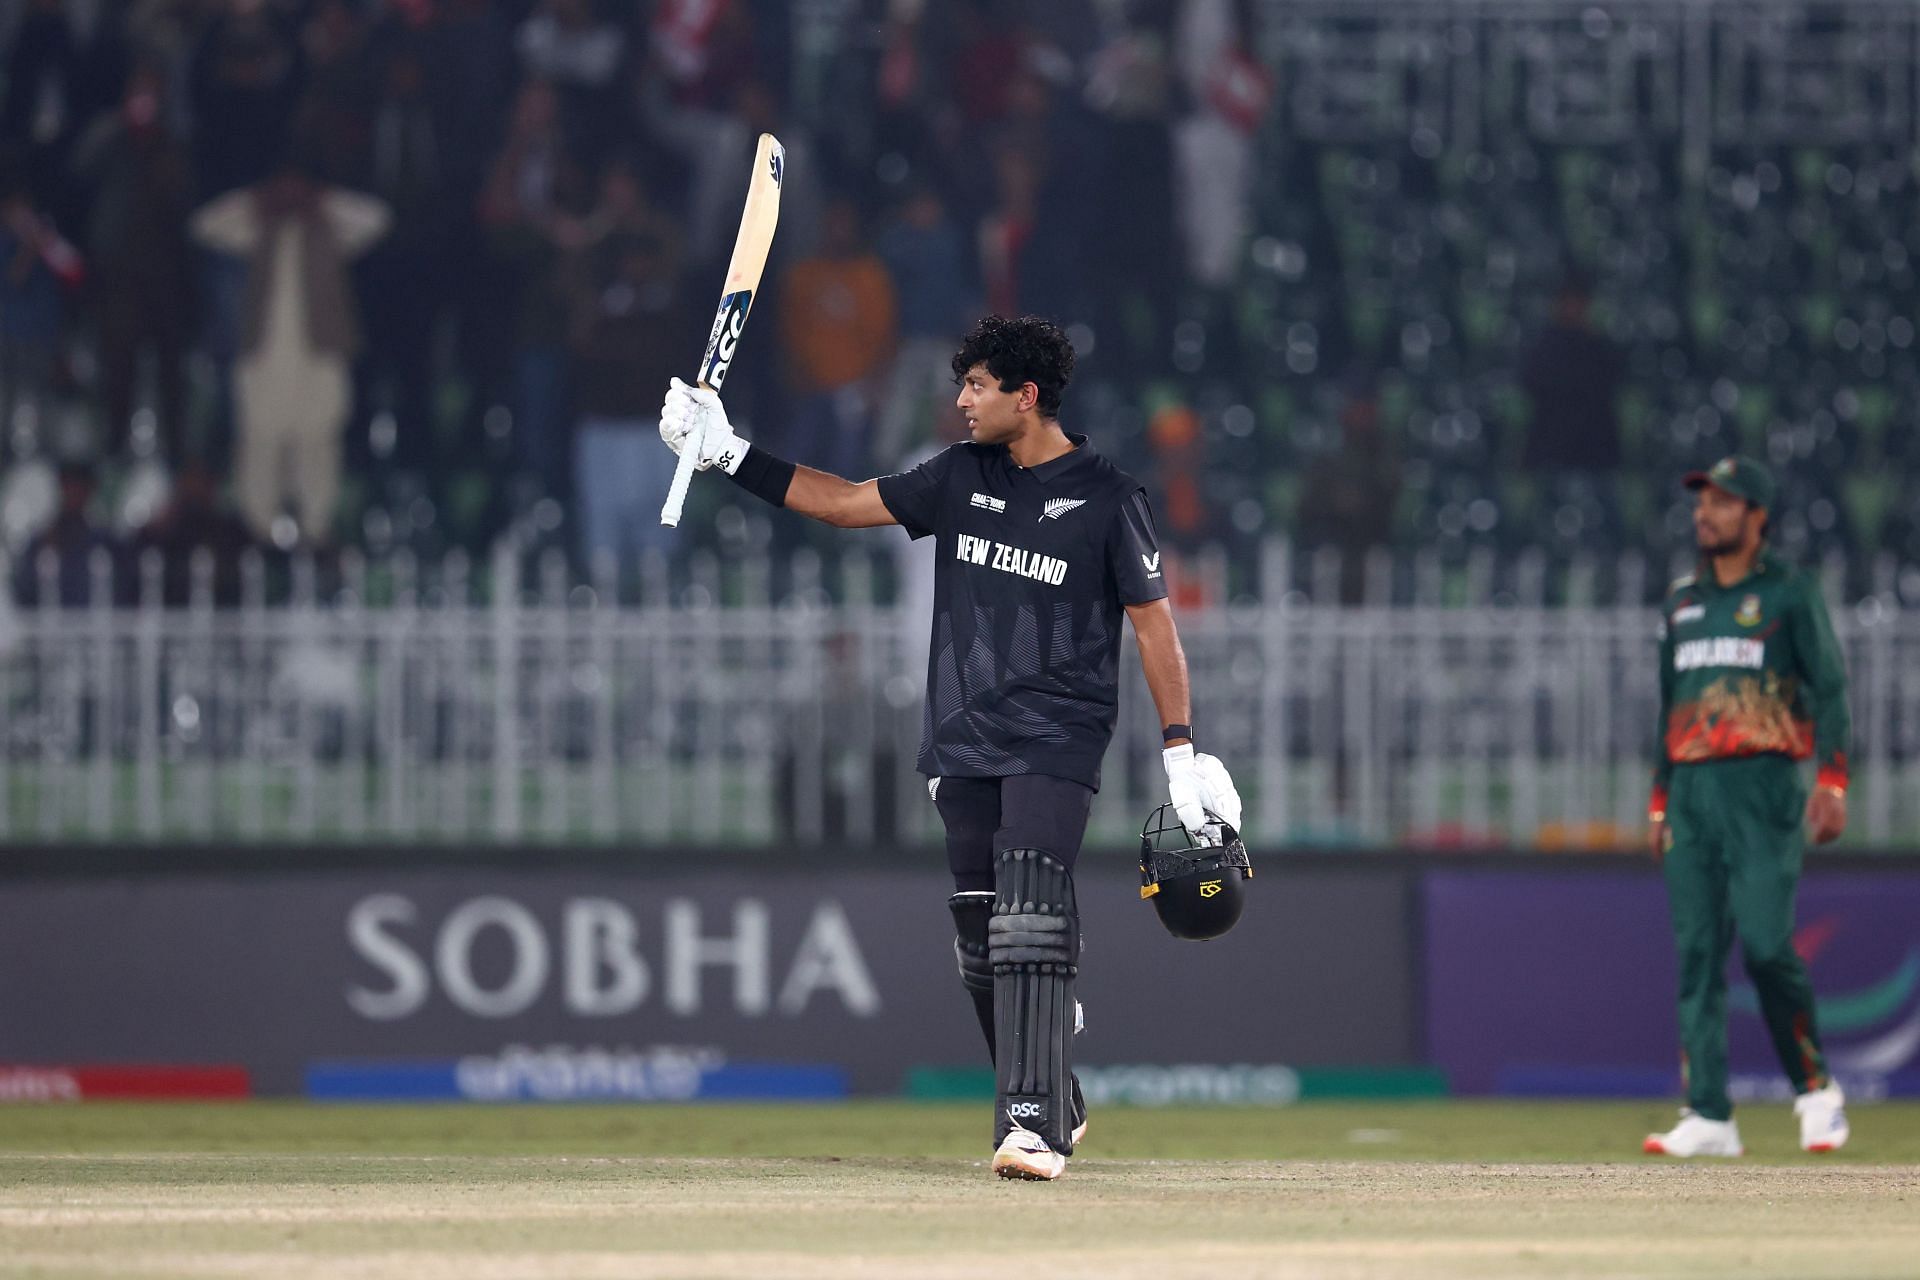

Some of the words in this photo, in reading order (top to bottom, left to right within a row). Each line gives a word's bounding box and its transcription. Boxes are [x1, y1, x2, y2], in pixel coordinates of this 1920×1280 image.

[709, 308, 742, 389] DSC
[956, 533, 991, 566] NEW
[991, 542, 1068, 586] ZEALAND
[347, 893, 881, 1018] SOBHA
[1011, 1102, 1040, 1117] DSC
